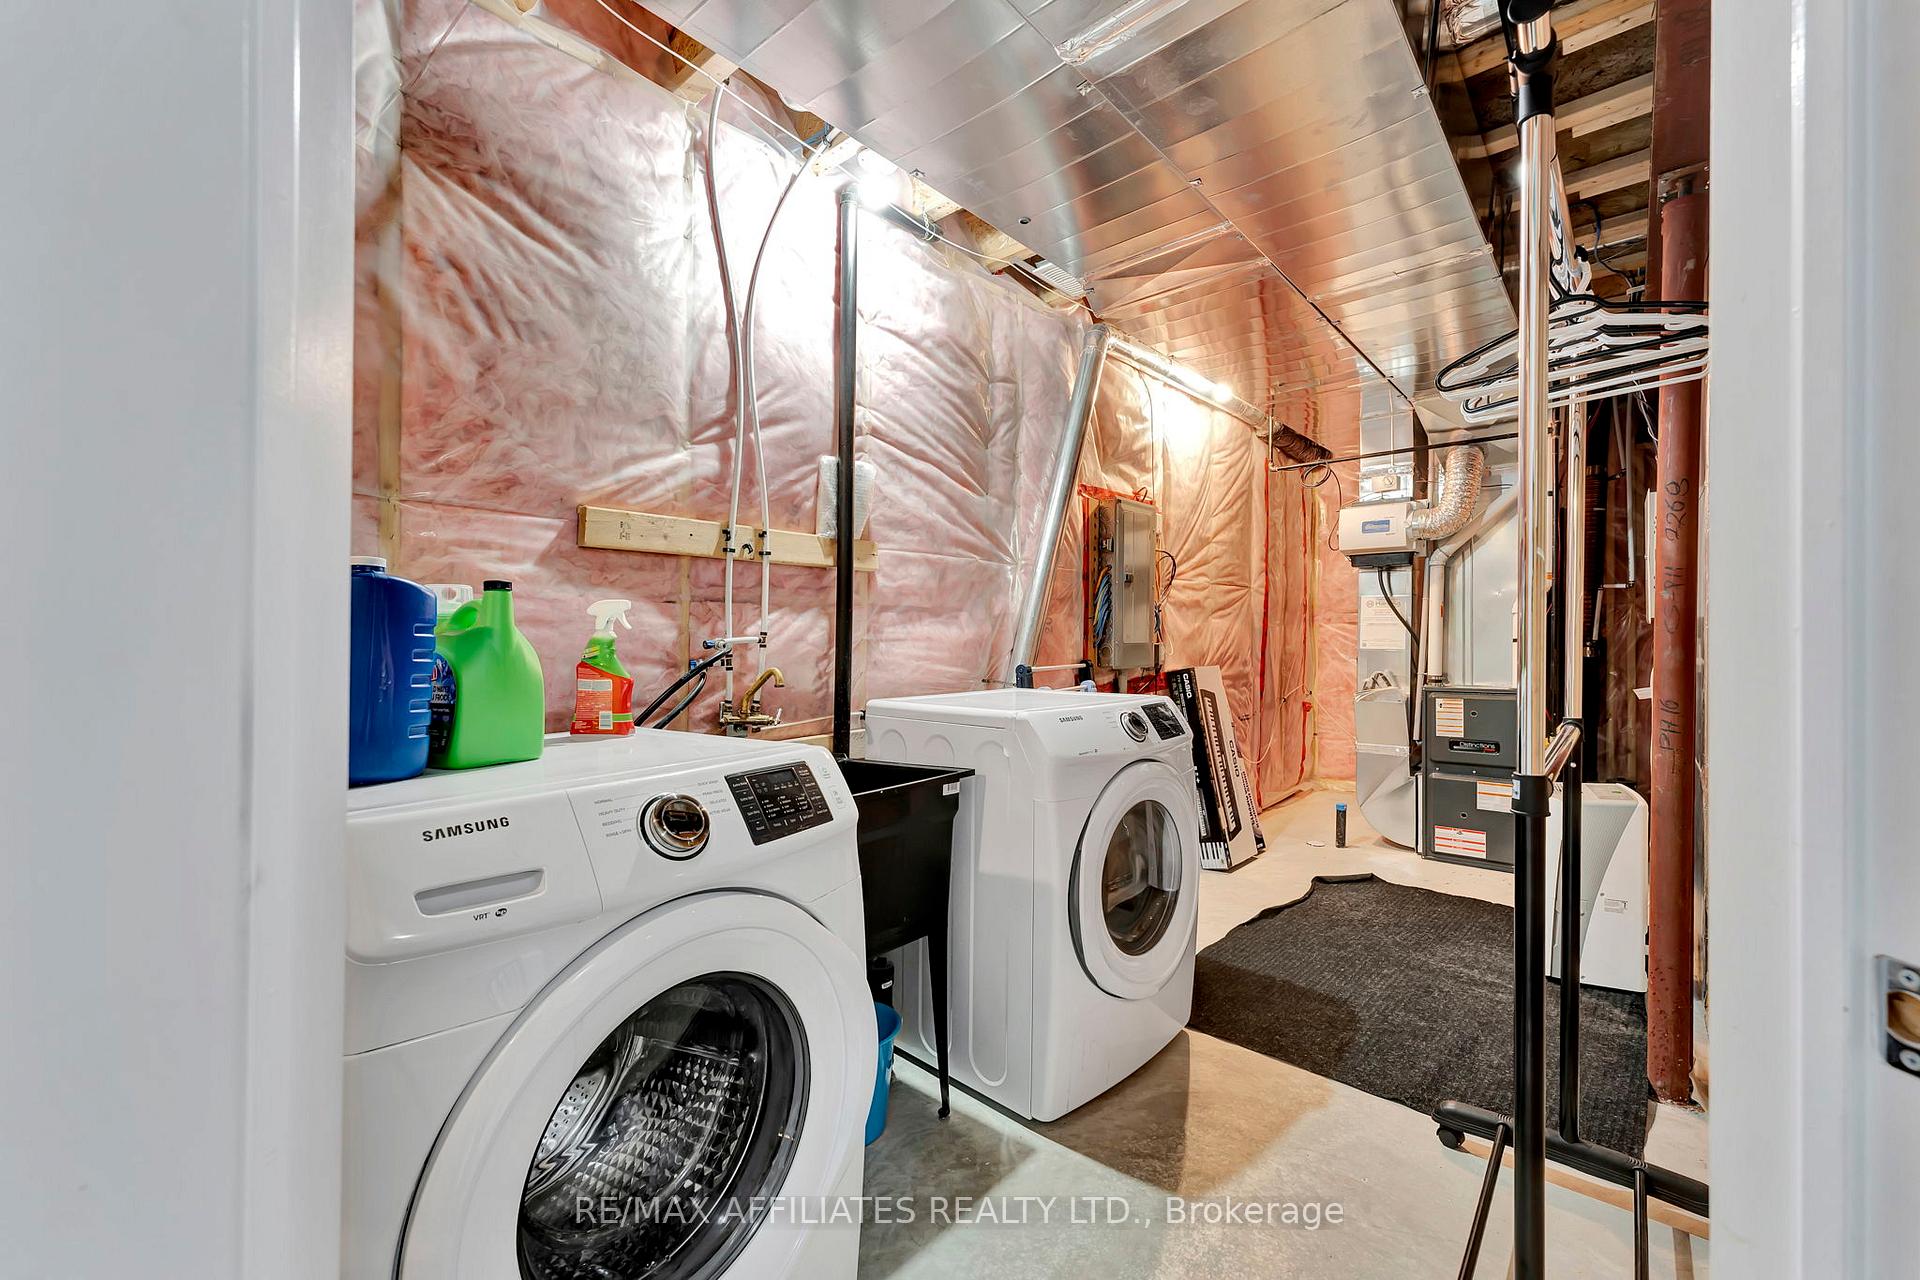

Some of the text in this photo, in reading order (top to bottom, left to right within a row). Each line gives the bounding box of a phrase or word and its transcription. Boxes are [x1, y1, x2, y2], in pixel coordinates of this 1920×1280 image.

[1182, 673, 1193, 699] CASIO
[1229, 740, 1240, 778] CASIO
[422, 816, 510, 842] SAMSUNG
